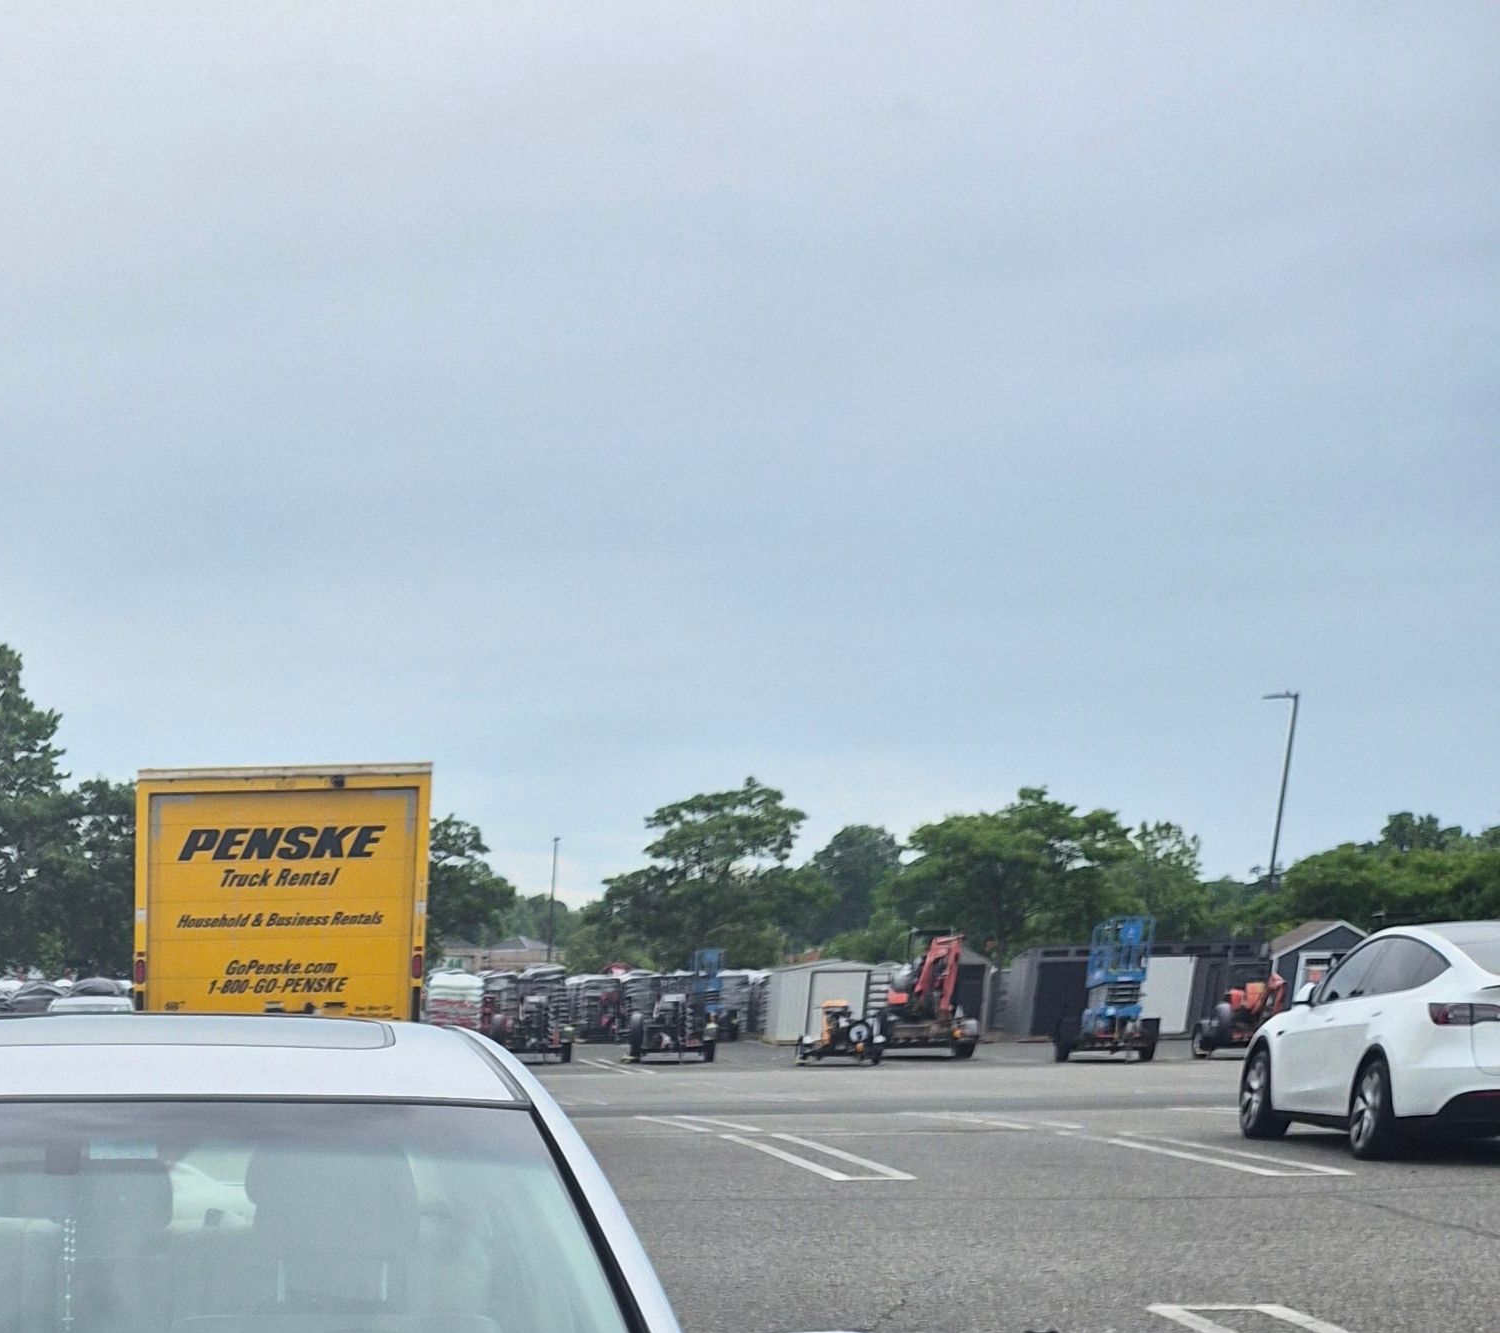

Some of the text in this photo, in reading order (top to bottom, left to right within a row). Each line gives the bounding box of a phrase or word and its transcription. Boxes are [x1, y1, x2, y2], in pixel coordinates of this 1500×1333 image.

[177, 825, 386, 862] PENSKE
[220, 867, 341, 887] Truck Rental
[177, 911, 384, 929] Household & Business Rentals
[225, 959, 338, 976] GoPenske.com
[208, 977, 349, 995] 1-800-GO-PENSKE
